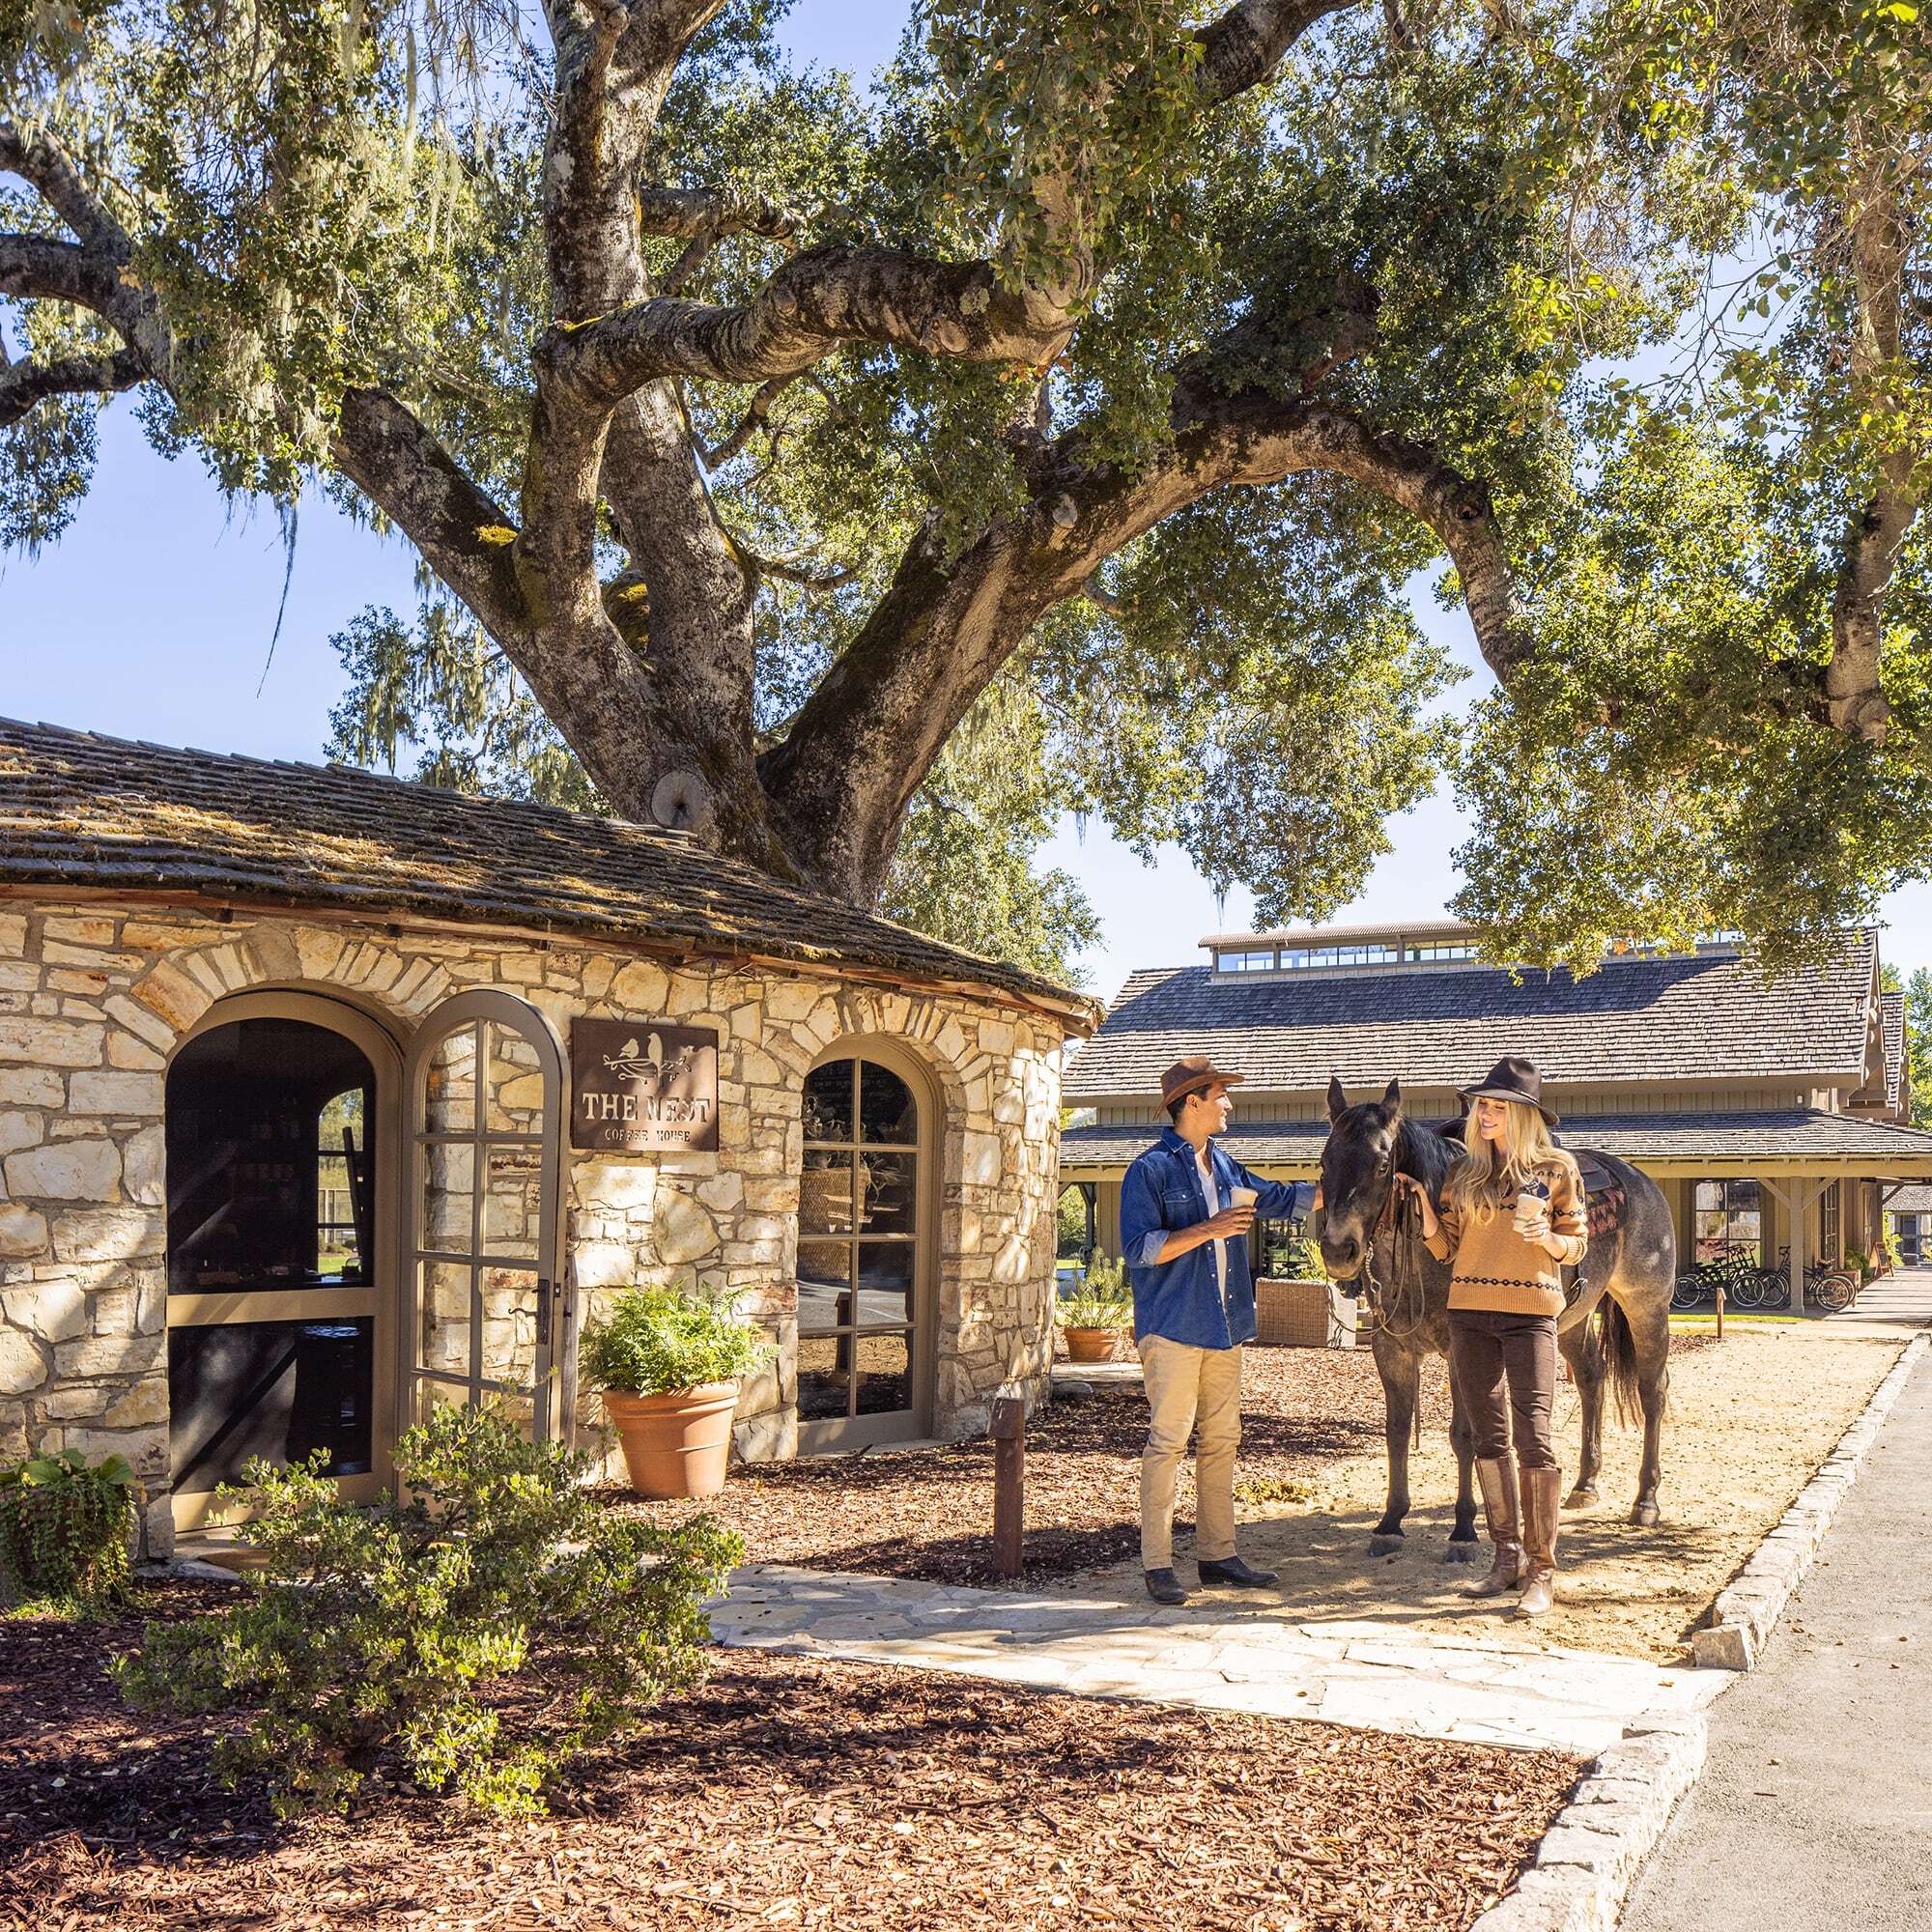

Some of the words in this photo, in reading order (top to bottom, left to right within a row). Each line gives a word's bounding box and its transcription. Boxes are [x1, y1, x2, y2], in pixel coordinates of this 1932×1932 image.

[582, 1093, 639, 1121] THE
[646, 1095, 711, 1122] NEST
[605, 1128, 648, 1142] COFFEE
[656, 1129, 691, 1142] HOUSE
